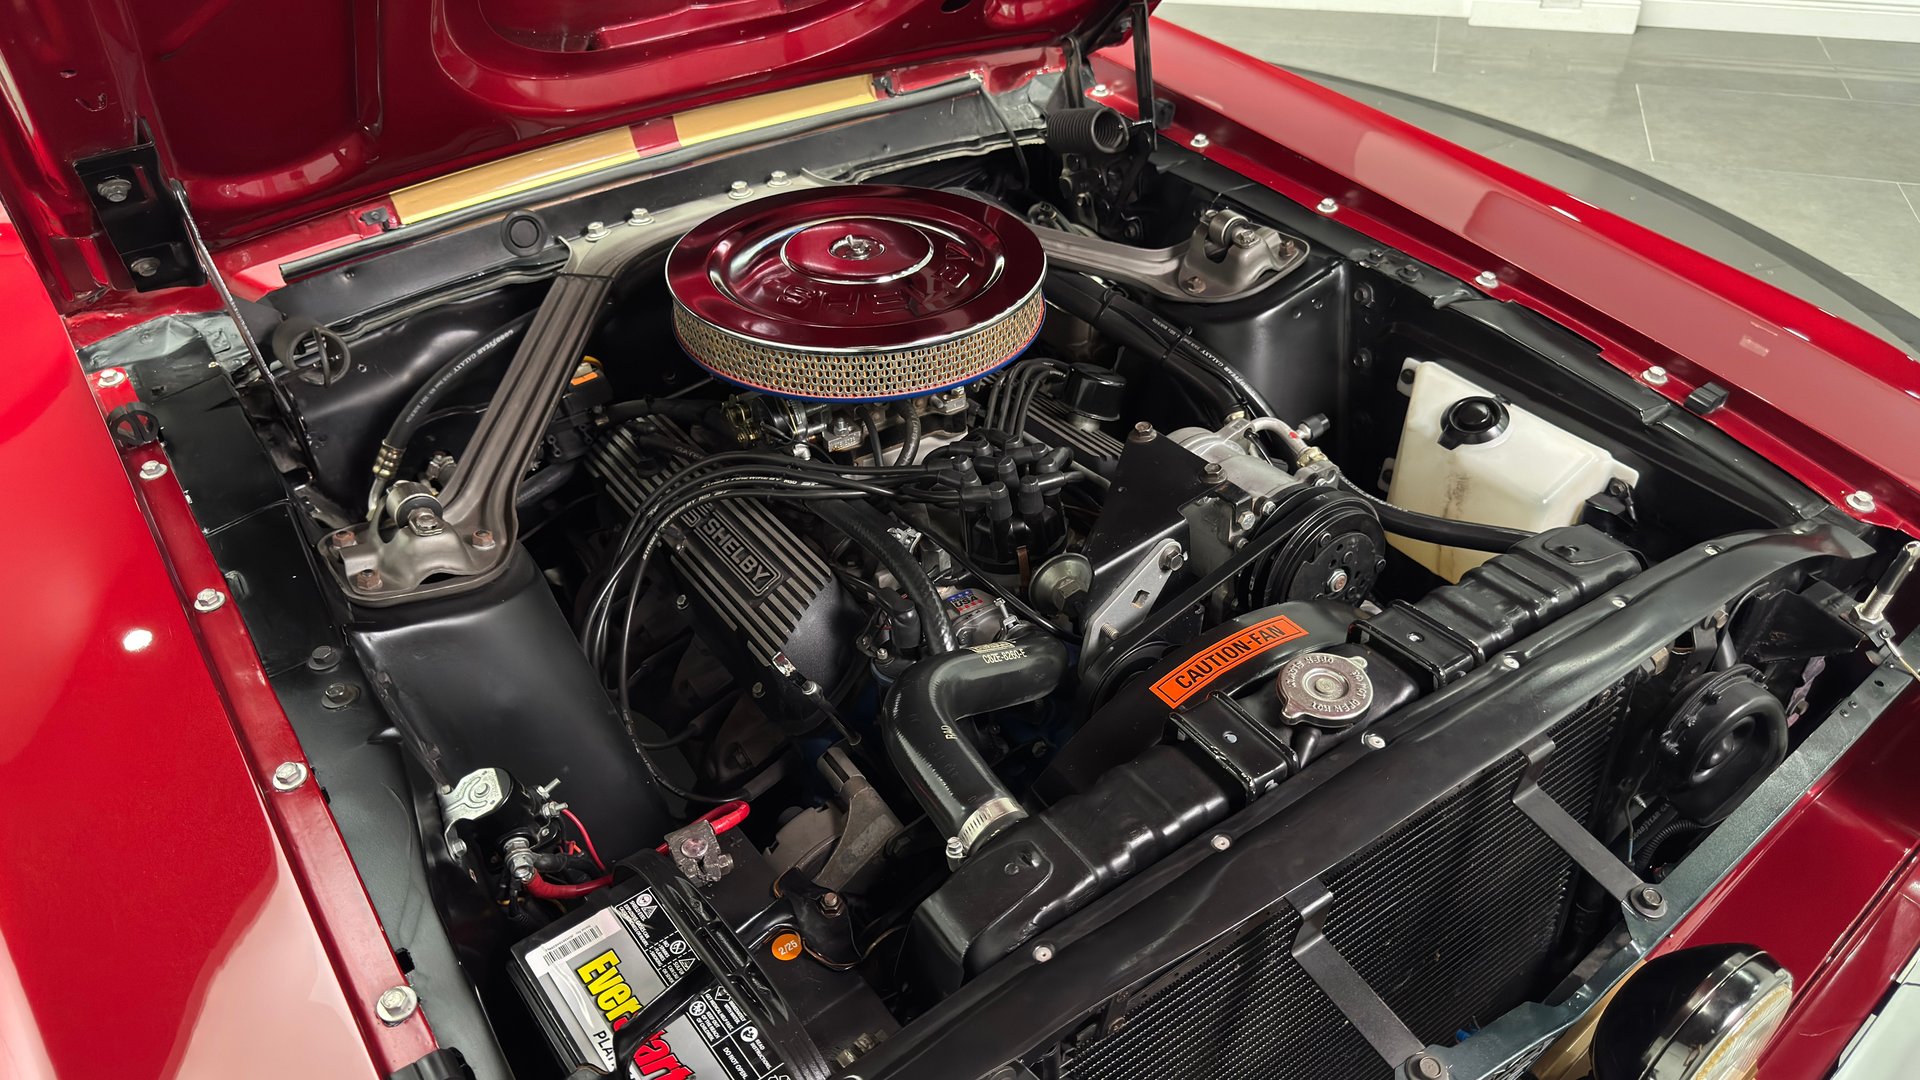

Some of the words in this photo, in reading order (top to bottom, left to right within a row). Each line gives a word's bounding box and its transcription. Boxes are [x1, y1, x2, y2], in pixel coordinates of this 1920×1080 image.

[453, 352, 478, 374] GALAXY
[702, 517, 771, 583] SHELBY
[954, 594, 978, 608] USA
[1174, 624, 1287, 690] CAUTION-FAN
[778, 939, 798, 957] 2/25
[673, 961, 684, 975] SULFUR
[709, 1026, 720, 1038] REACH
[712, 1020, 720, 1028] OUT
[755, 1039, 765, 1050] READ
[723, 1047, 731, 1055] DO
[728, 1054, 739, 1065] NOT
[735, 1064, 749, 1079] OPEN.
